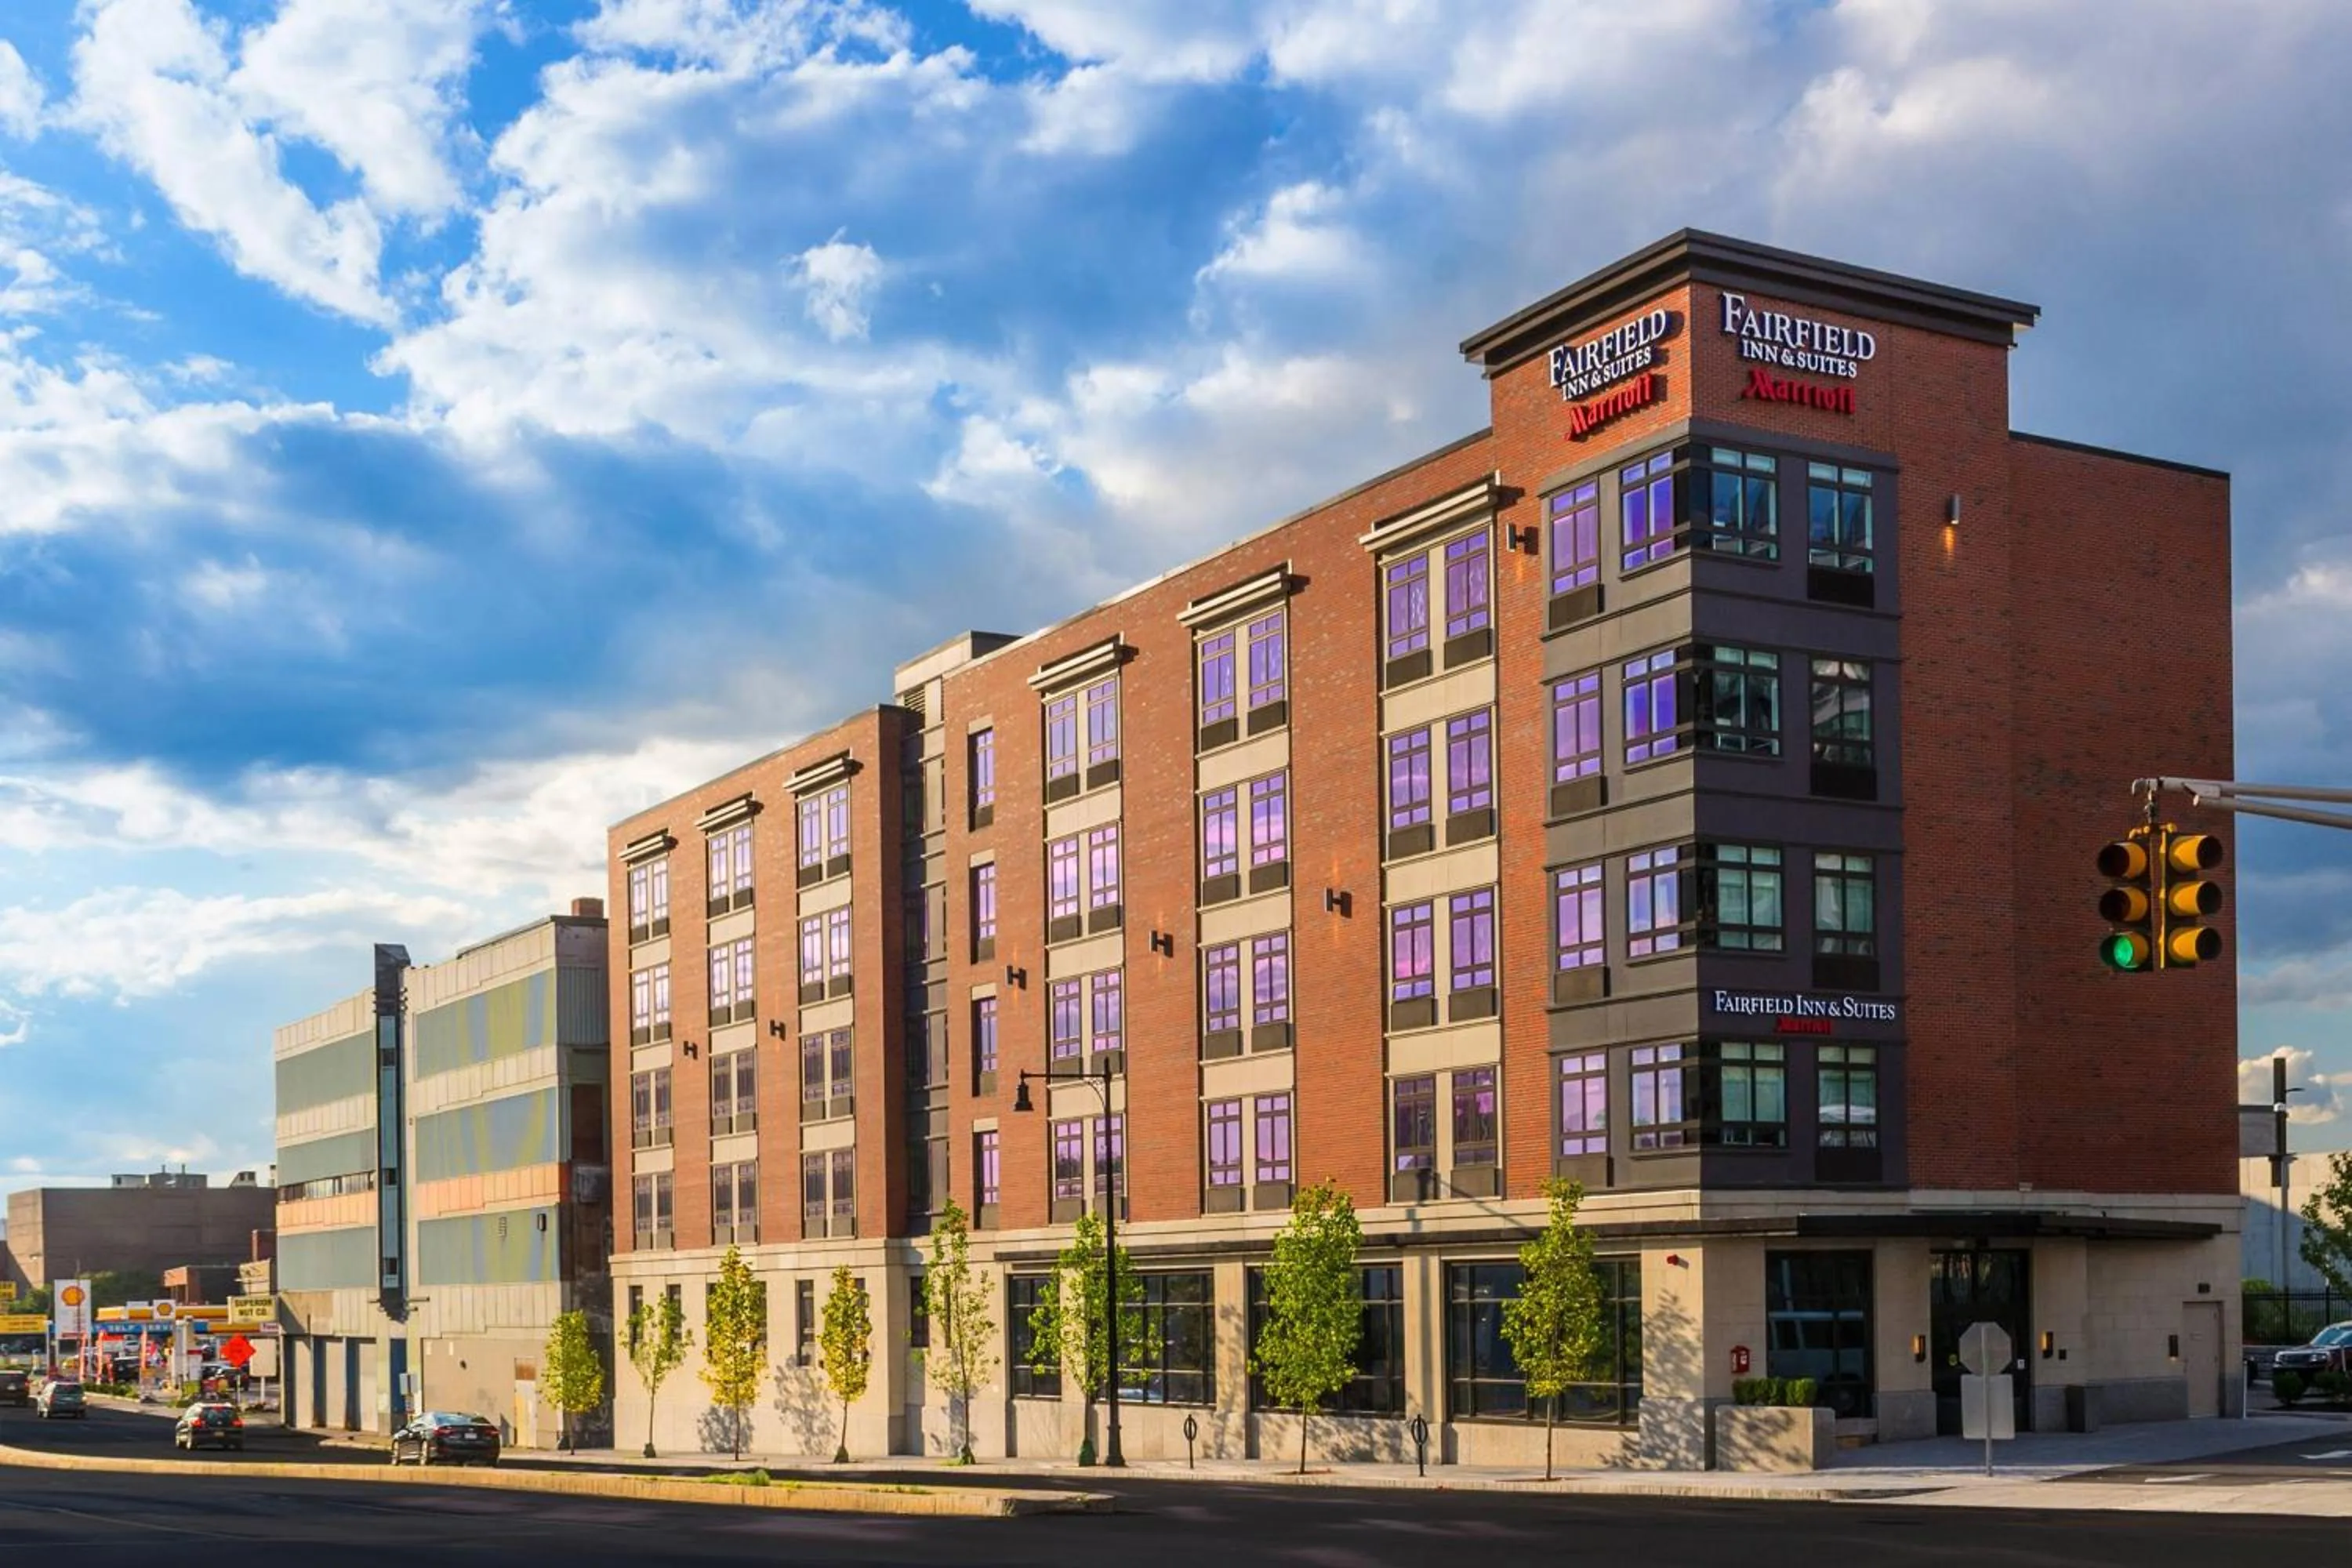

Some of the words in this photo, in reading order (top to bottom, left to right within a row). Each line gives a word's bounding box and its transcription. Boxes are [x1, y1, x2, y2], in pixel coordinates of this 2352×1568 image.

[1547, 308, 1667, 388] FAIRFIELD
[1722, 291, 1877, 361] FAIRFIELD
[1561, 376, 1589, 401] INN
[1590, 370, 1602, 389] &
[1602, 345, 1653, 384] SUITES
[1742, 338, 1778, 364] INN
[1781, 348, 1795, 367] &
[1797, 350, 1858, 379] SUITES
[1563, 371, 1654, 441] Marriott
[1741, 366, 1857, 415] Marriott
[1715, 989, 1794, 1015] FAIRFIELD
[1796, 994, 1826, 1016] INN
[1828, 1001, 1841, 1017] &
[1842, 996, 1896, 1020] SUITES
